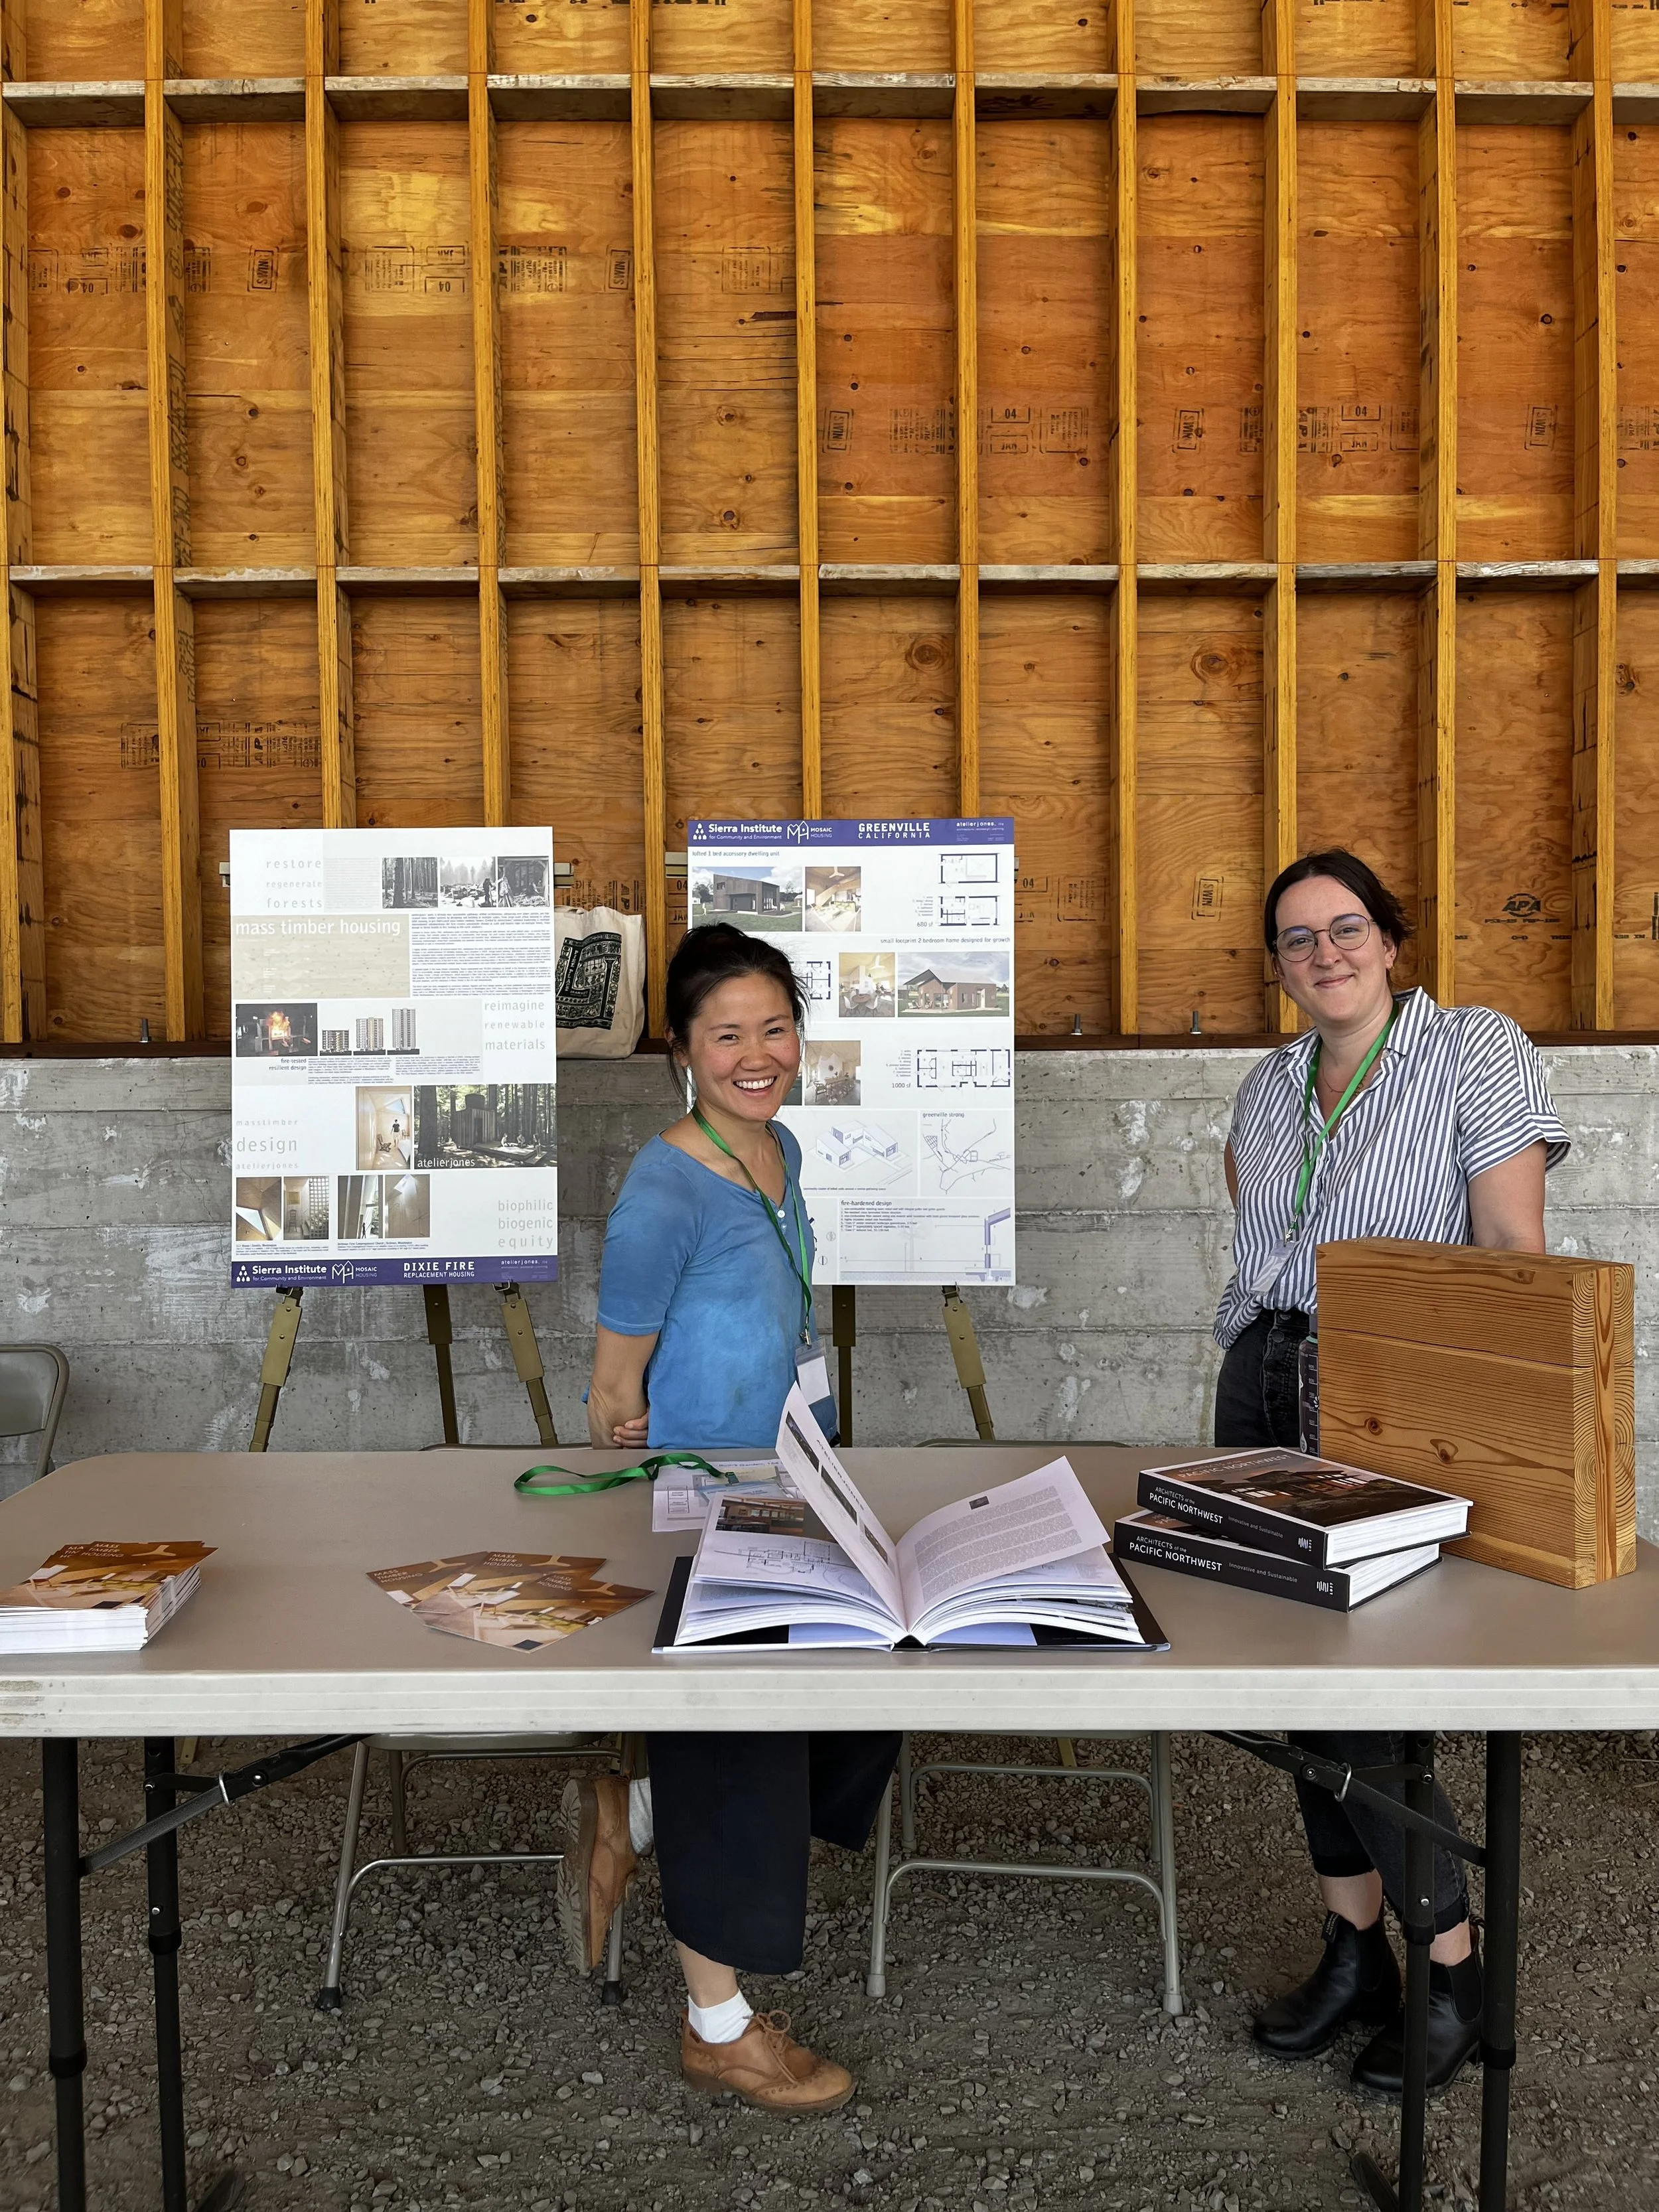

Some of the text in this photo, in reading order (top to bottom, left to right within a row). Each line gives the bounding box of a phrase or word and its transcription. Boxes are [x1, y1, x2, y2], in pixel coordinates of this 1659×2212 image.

[438, 282, 451, 293] 04
[1005, 407, 1017, 419] 04
[1355, 406, 1368, 417] 04
[709, 824, 782, 833] Sierra Institute
[859, 822, 930, 832] GREENVILLE
[267, 859, 321, 868] restore
[1023, 878, 1035, 888] 04
[267, 898, 322, 908] forests
[1502, 900, 1541, 912] APA
[236, 921, 275, 934] mass
[281, 919, 334, 934] timber
[340, 919, 400, 936] housing
[484, 1000, 544, 1011] reimagine
[484, 1020, 544, 1029] renewable
[485, 1038, 545, 1050] materials
[236, 1137, 297, 1153] design
[417, 1157, 475, 1168] atelierjones
[498, 1200, 553, 1213] biophilic
[498, 1217, 553, 1230] biogenic
[498, 1235, 553, 1249] equity
[252, 1265, 327, 1274] Sierra Institute
[403, 1262, 474, 1271] DIXIE FIRE
[1177, 1454, 1291, 1478] PACIFIC NORTHWEST
[1155, 1487, 1185, 1502] ARCHITECTS
[1149, 1492, 1223, 1524] PACIFIC NORTHWEST
[1228, 1516, 1249, 1526] Innovative
[1259, 1524, 1283, 1538] Sustainable
[1136, 1536, 1173, 1550] ARCHITECTS
[1129, 1542, 1222, 1572] PACIFIC NORTHWEST
[380, 1572, 423, 1584] HOUSING
[1229, 1562, 1256, 1574] Innovative
[1267, 1570, 1297, 1583] Sustainable
[536, 1581, 572, 1591] HOUSING
